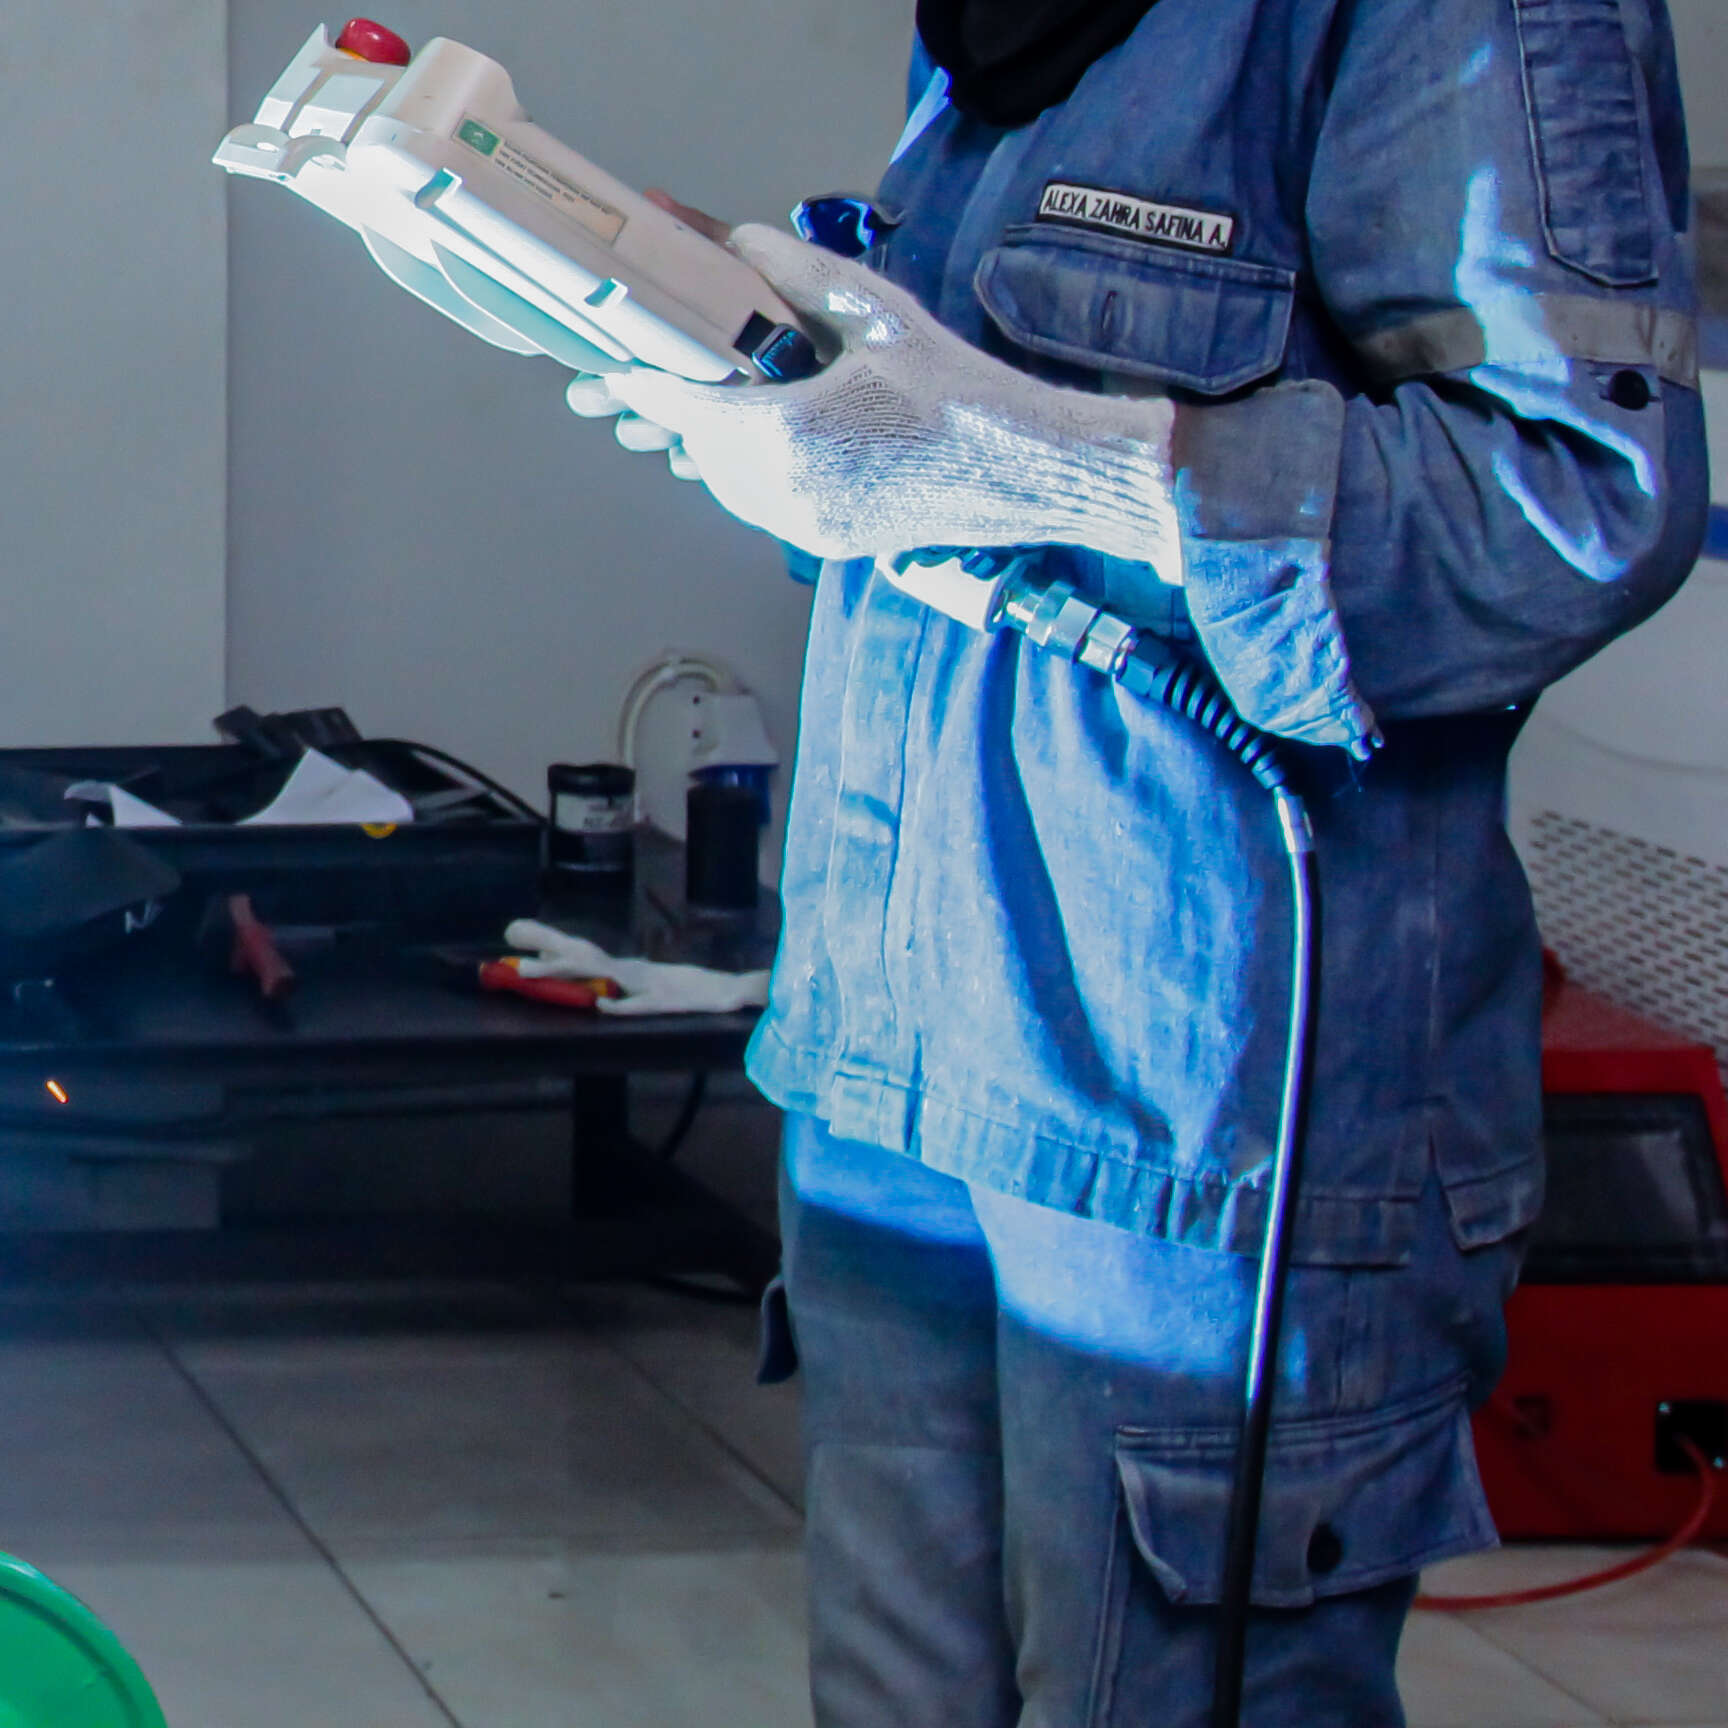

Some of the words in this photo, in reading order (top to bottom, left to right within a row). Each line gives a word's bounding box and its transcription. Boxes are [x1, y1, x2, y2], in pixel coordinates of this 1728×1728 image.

[1043, 187, 1088, 217] ALEXA
[1087, 197, 1142, 229] ZAHRA
[1143, 210, 1204, 242] SAFINA
[1208, 222, 1228, 247] A.
